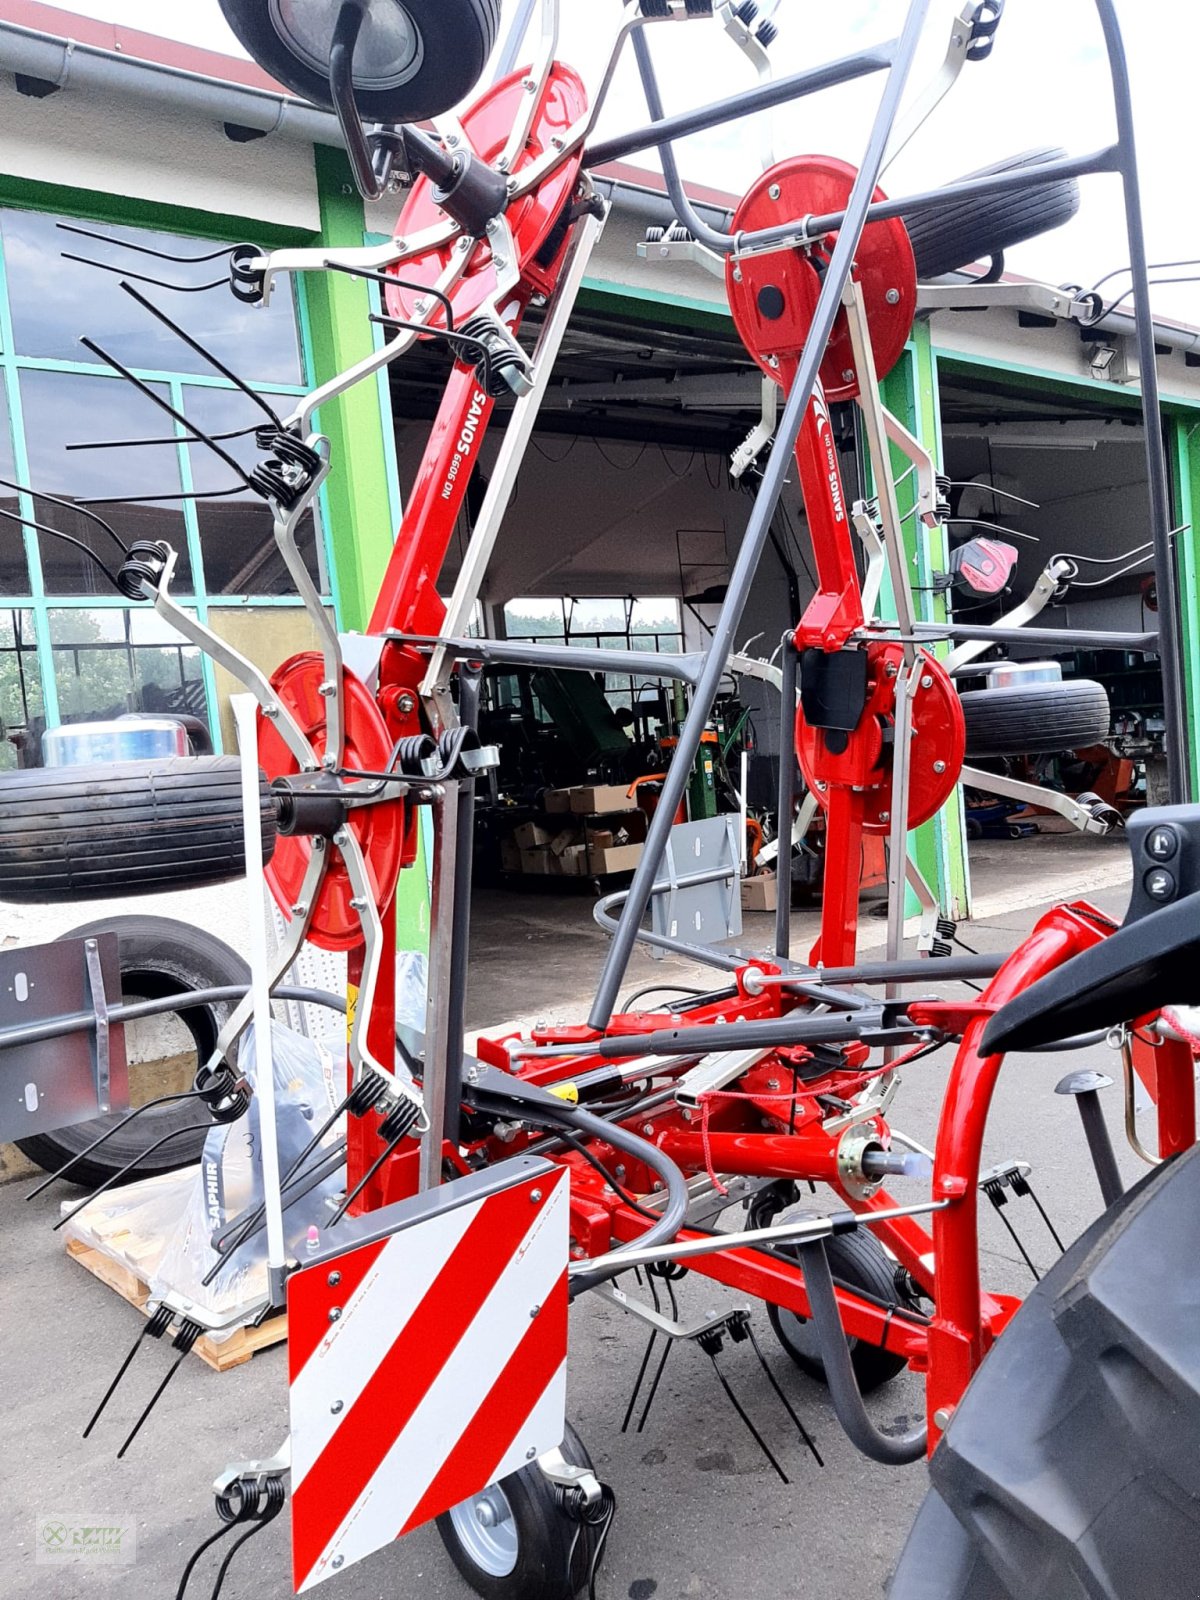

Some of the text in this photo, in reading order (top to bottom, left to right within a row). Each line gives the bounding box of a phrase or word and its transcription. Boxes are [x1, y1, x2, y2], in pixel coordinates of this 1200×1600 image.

[441, 390, 486, 499] SANOS 6606 DN
[829, 471, 844, 522] SANOS
[206, 1162, 221, 1230] SAPHIR
